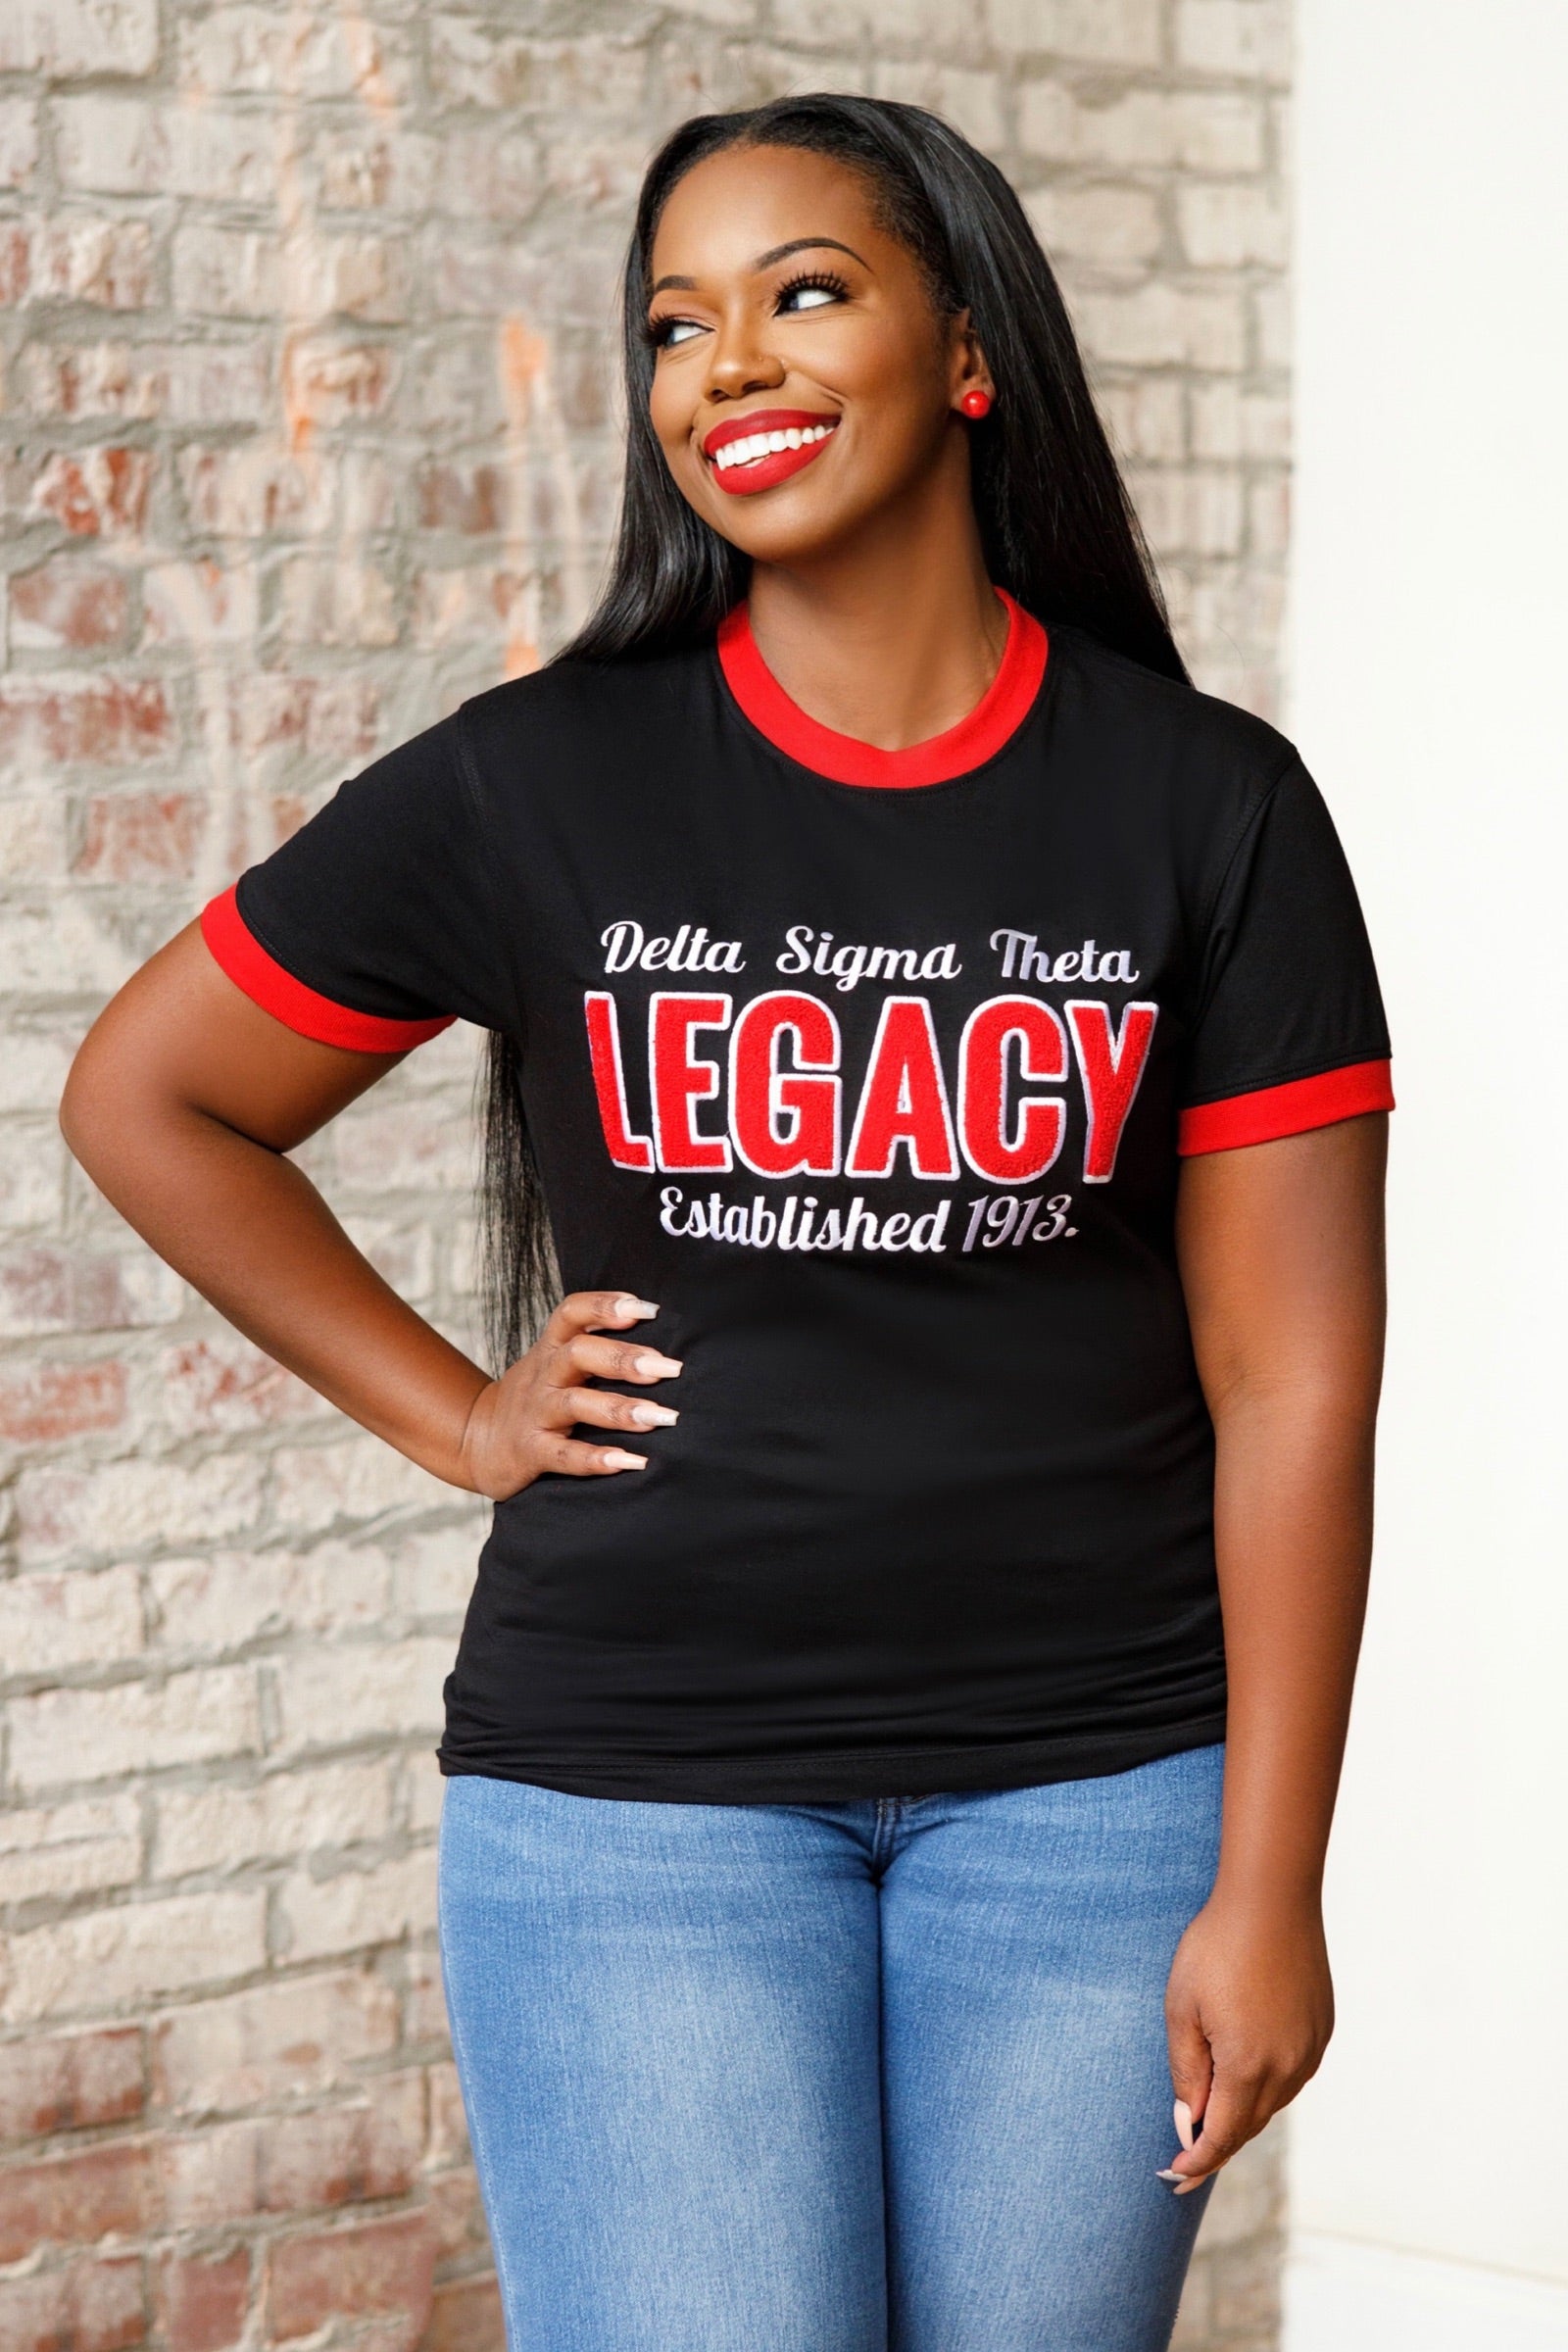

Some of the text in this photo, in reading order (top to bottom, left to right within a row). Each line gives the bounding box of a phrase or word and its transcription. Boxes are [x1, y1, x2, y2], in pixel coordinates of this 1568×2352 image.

[600, 920, 1141, 993] Delta Sigma Theta
[583, 990, 1159, 1186] LEGACY
[660, 1186, 1079, 1253] Established 1913.
